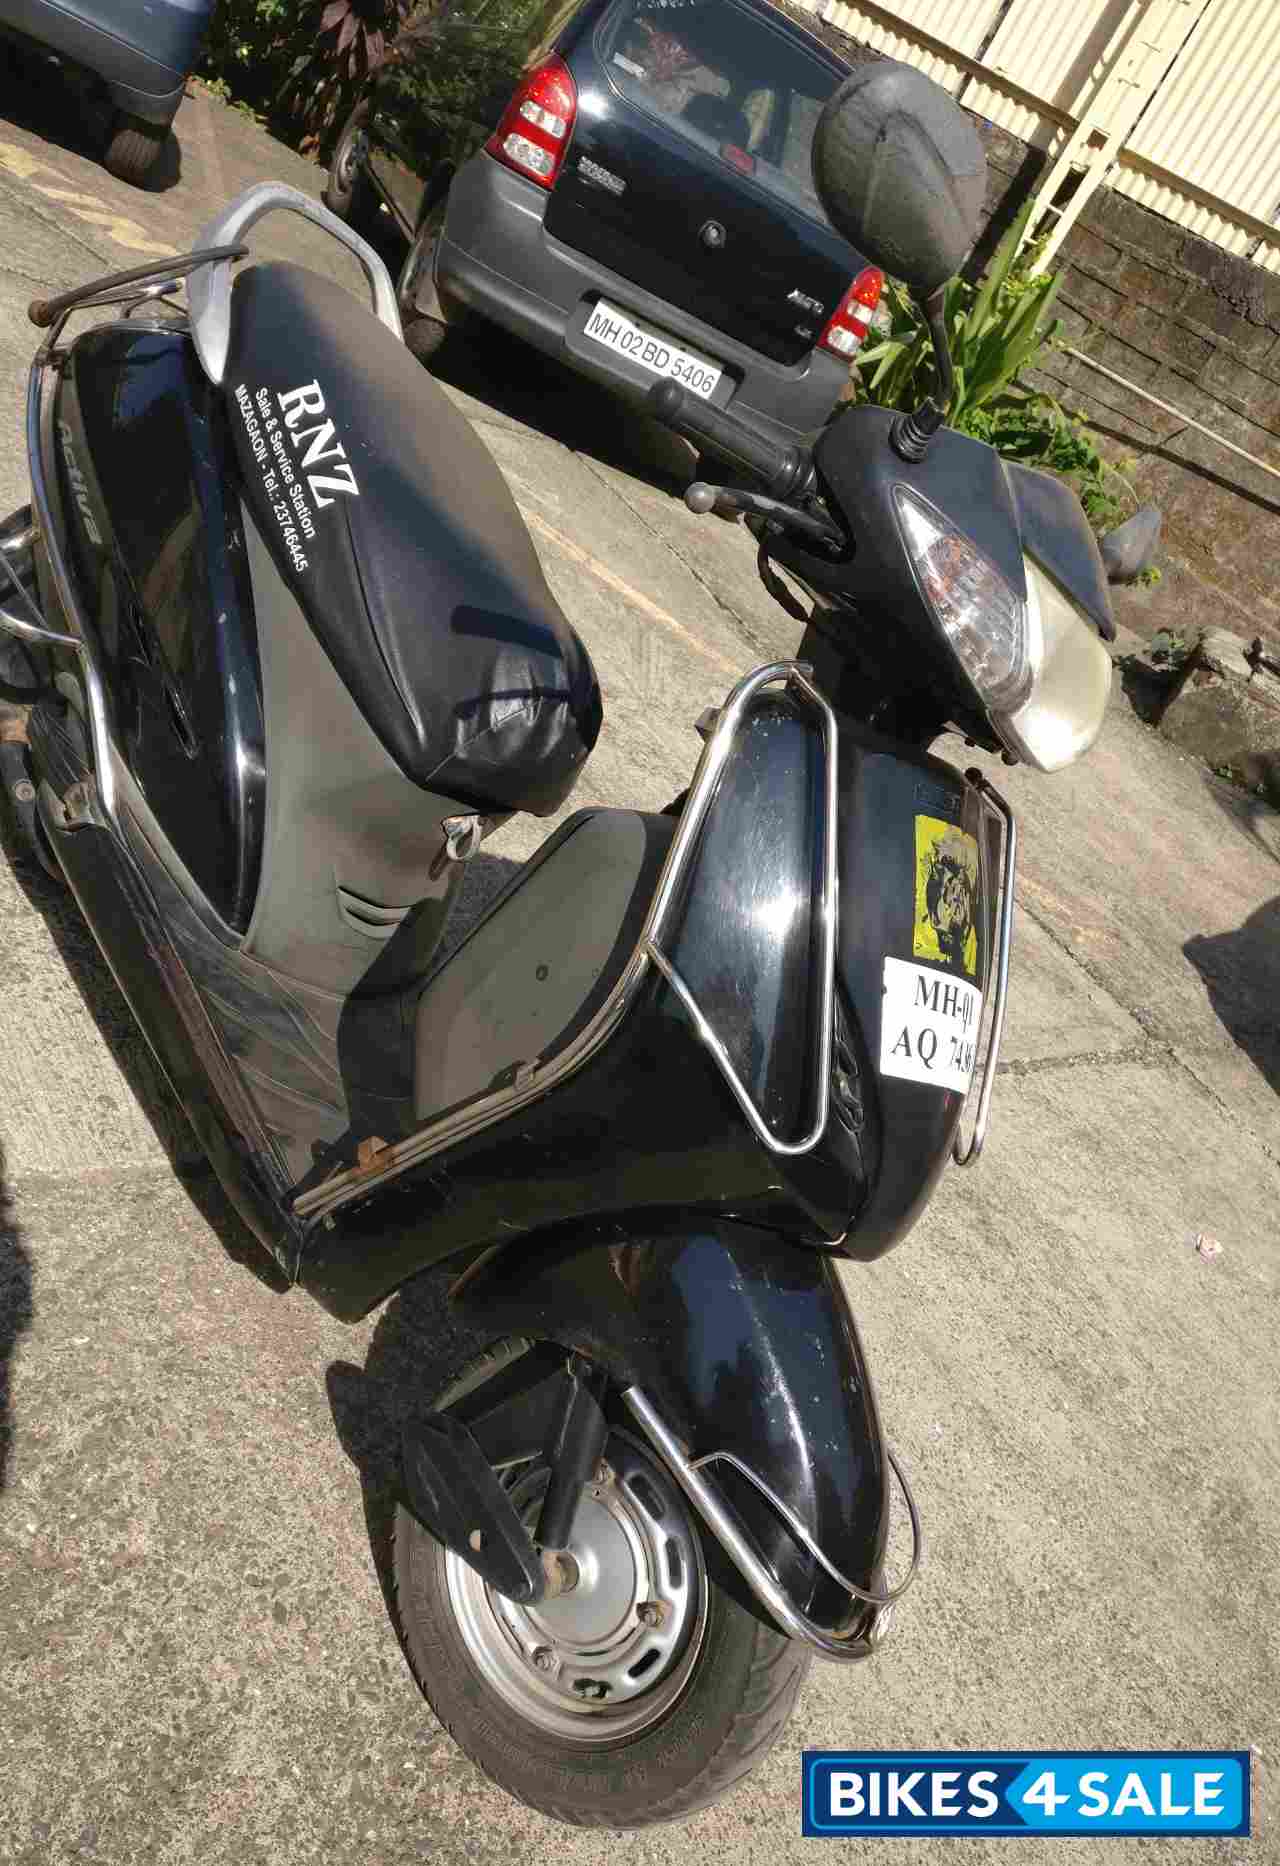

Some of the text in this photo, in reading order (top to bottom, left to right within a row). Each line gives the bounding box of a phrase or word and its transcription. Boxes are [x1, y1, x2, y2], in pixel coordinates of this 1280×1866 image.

[588, 312, 714, 393] MH 02 BD 5406
[235, 383, 268, 462] MAZAGAON
[273, 500, 309, 572] 23746445
[256, 387, 316, 538] Sale & Service Station
[277, 379, 359, 508] RNZ
[890, 1026, 938, 1071] AQ
